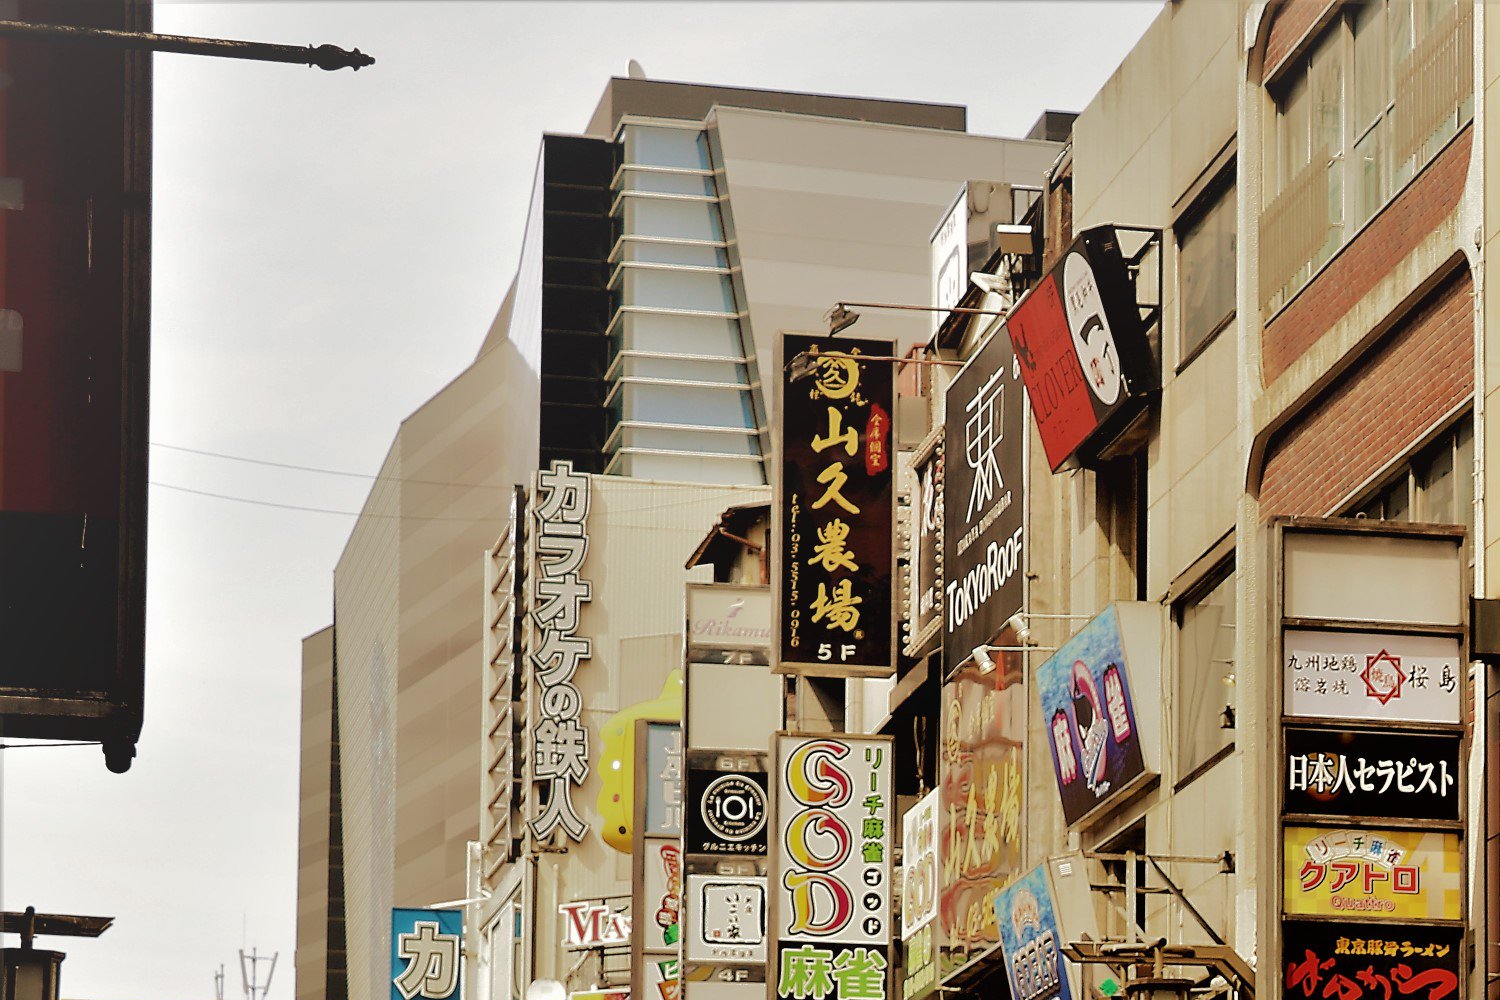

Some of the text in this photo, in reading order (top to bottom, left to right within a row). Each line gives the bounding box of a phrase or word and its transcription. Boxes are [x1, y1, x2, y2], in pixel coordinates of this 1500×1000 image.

[808, 406, 863, 632] 山久農場
[531, 461, 592, 843] カラオケの鉄人
[817, 643, 857, 661] 5F
[1287, 654, 1357, 673] 九州地鶏
[1407, 663, 1458, 694] 桜島
[1288, 753, 1455, 797] 日本人セラピスト
[1313, 834, 1403, 867] リーチ麻雀
[1300, 861, 1421, 894] クアトロ
[1331, 895, 1396, 912] Quattro
[562, 904, 632, 946] MA
